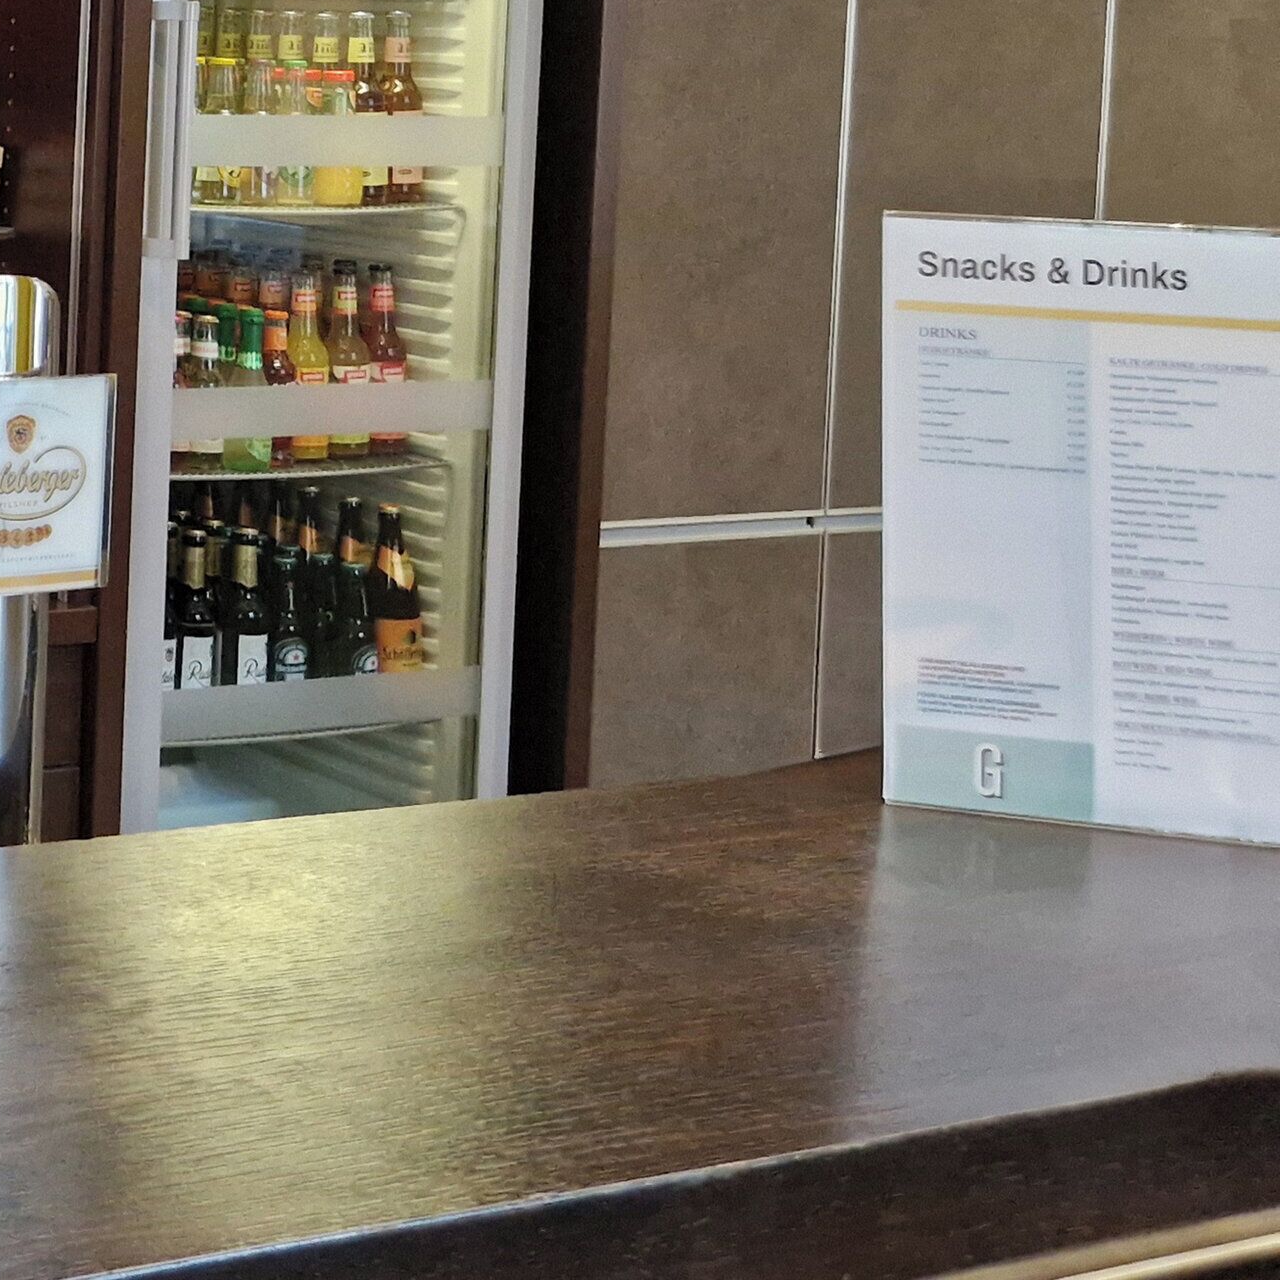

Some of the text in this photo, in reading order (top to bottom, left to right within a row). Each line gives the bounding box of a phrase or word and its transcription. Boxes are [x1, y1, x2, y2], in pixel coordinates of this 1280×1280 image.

[918, 250, 1188, 291] Snacks & Drinks
[919, 327, 977, 340] DRINKS
[975, 742, 1004, 799] G
